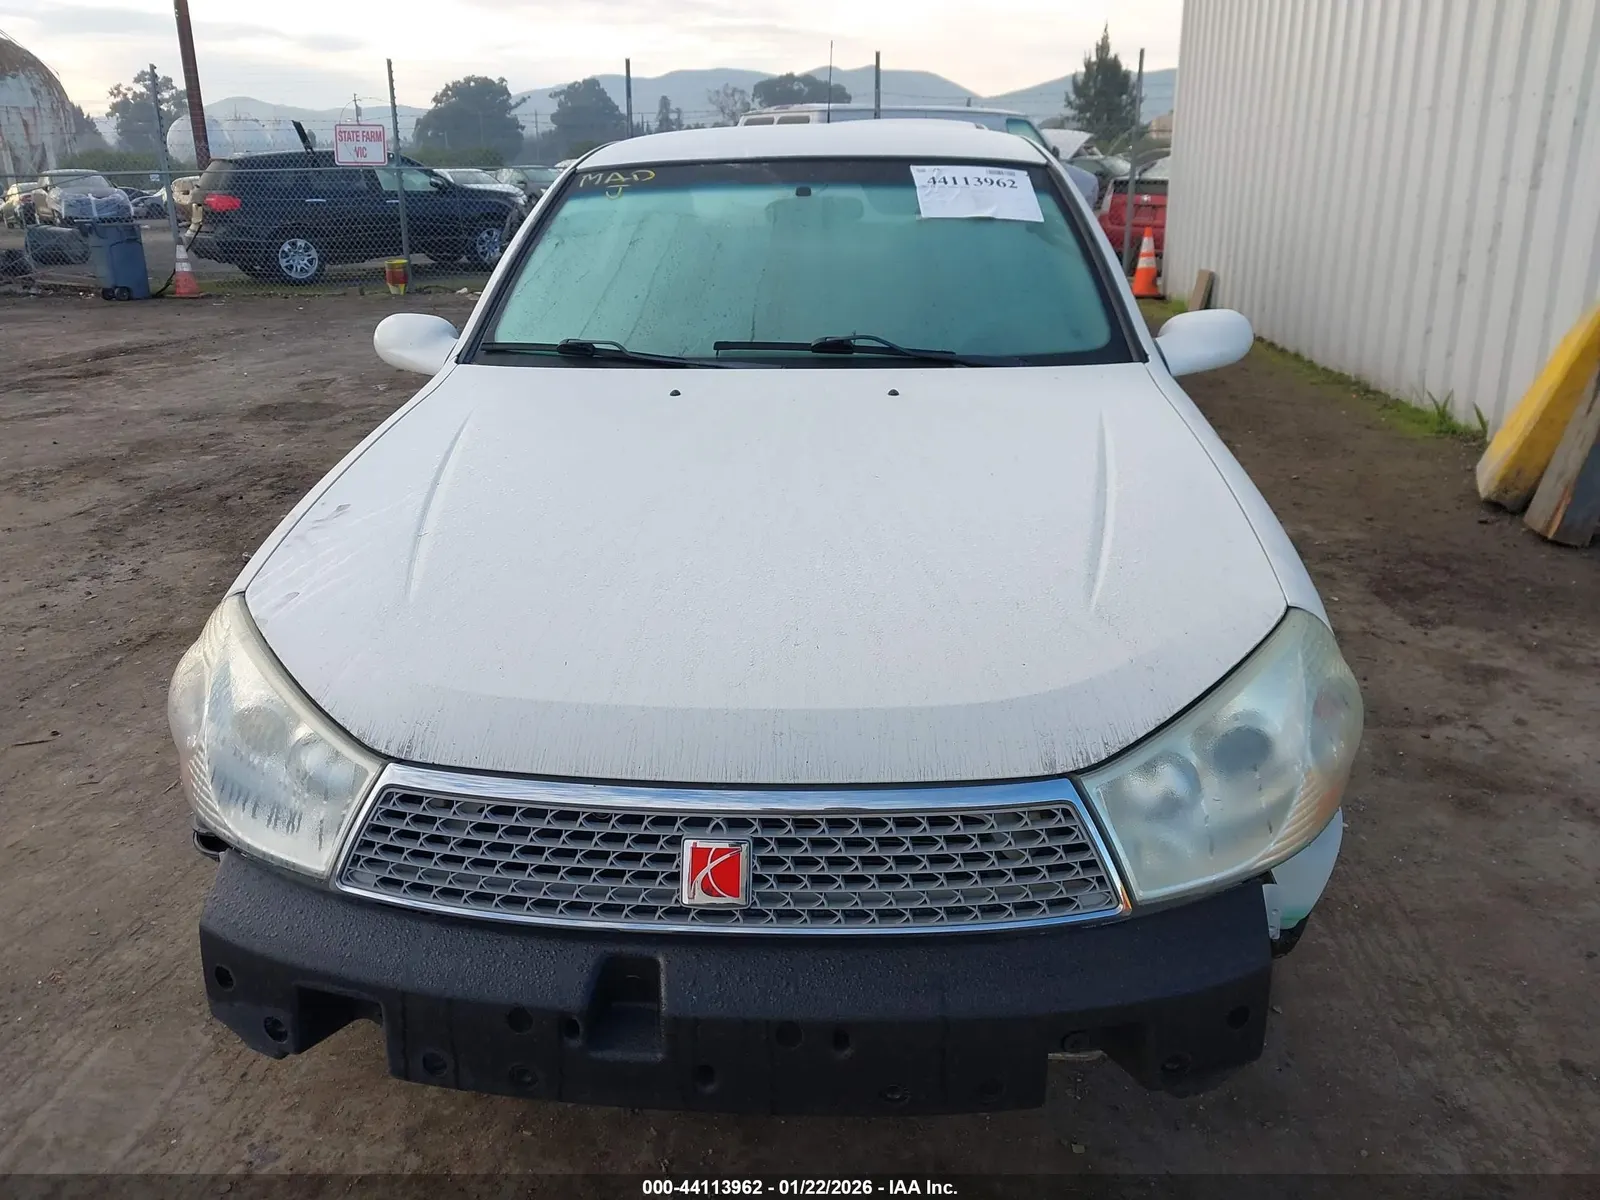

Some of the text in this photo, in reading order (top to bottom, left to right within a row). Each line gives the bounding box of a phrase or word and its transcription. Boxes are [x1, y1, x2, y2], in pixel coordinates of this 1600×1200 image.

[338, 130, 383, 142] STATE FARM
[354, 146, 367, 158] VIC
[579, 169, 656, 188] MAD
[927, 175, 1018, 189] 44113962
